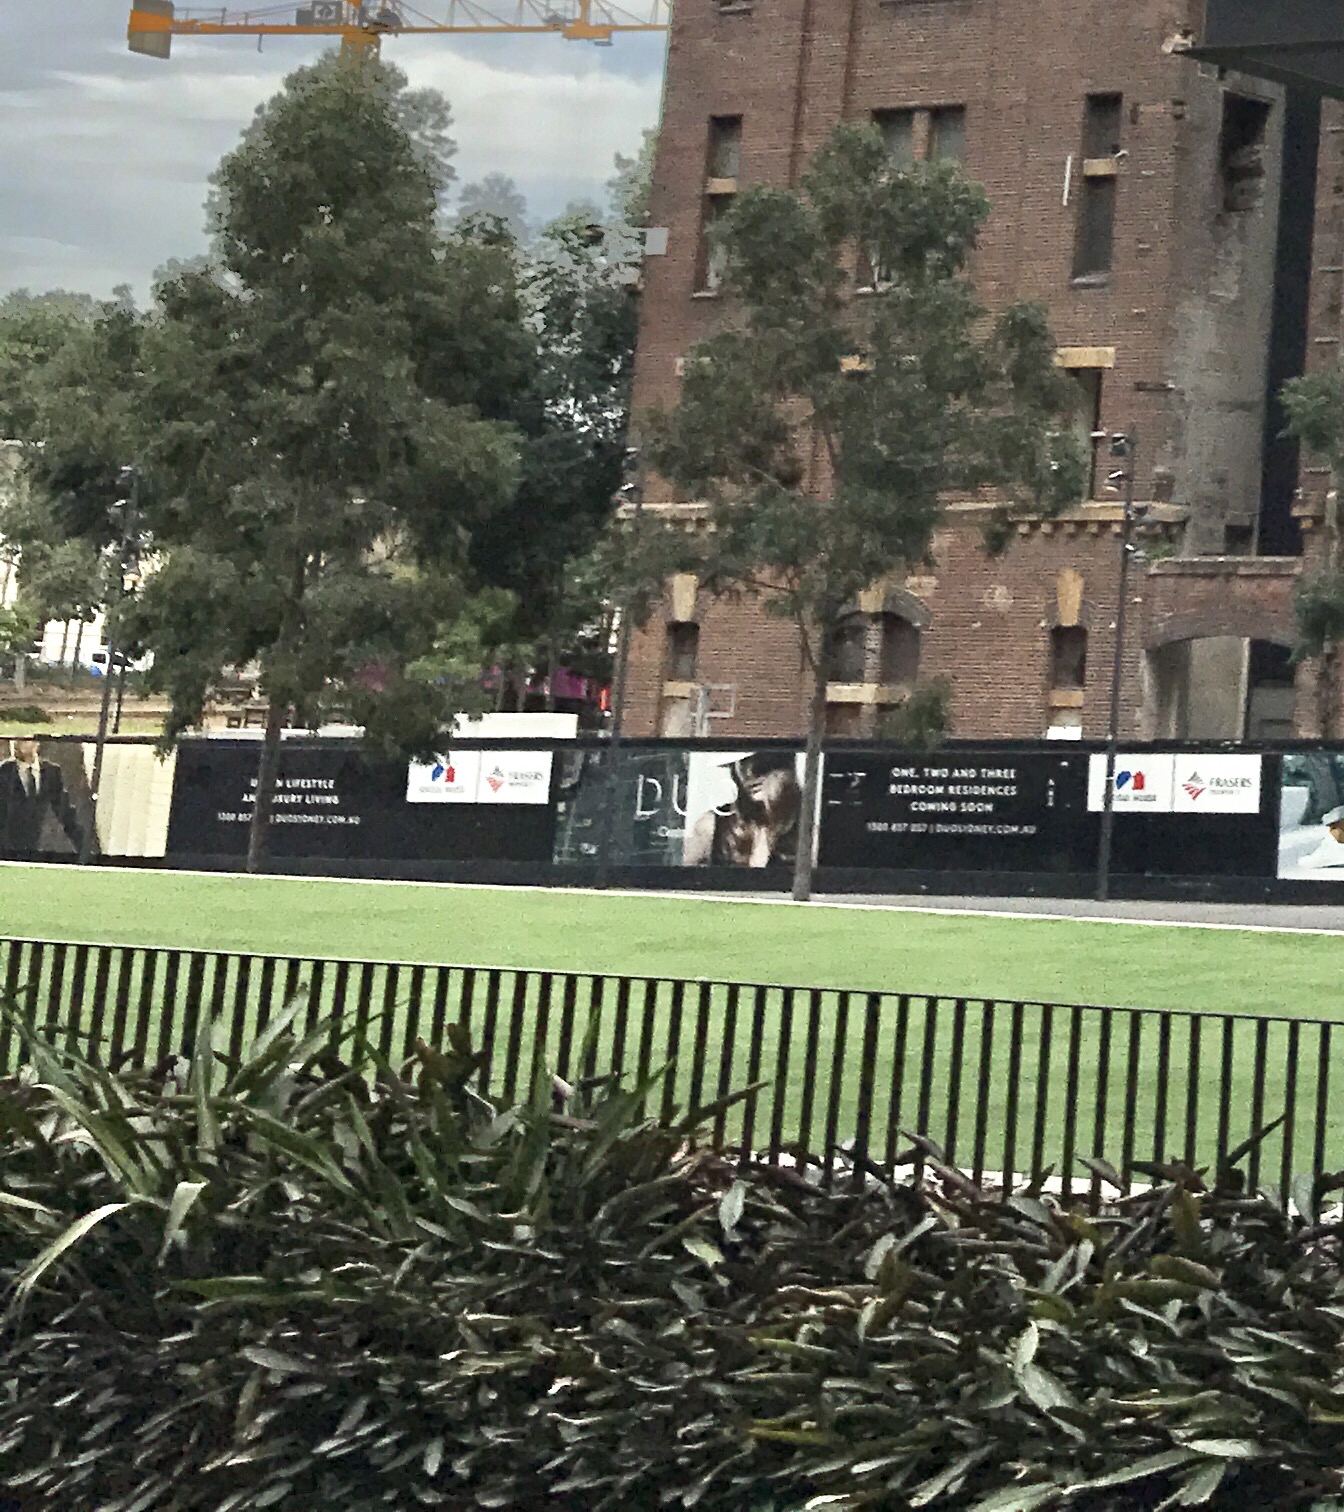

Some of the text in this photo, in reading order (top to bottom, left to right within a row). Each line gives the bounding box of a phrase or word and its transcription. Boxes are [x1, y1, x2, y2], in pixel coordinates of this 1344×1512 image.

[923, 768, 949, 778] TWO
[952, 768, 977, 779] AND
[981, 769, 1017, 779] THREE
[1209, 777, 1253, 788] FRASERS
[889, 784, 1017, 796] BEDROOM RESIDENCES
[911, 801, 993, 813] COMING SOON
